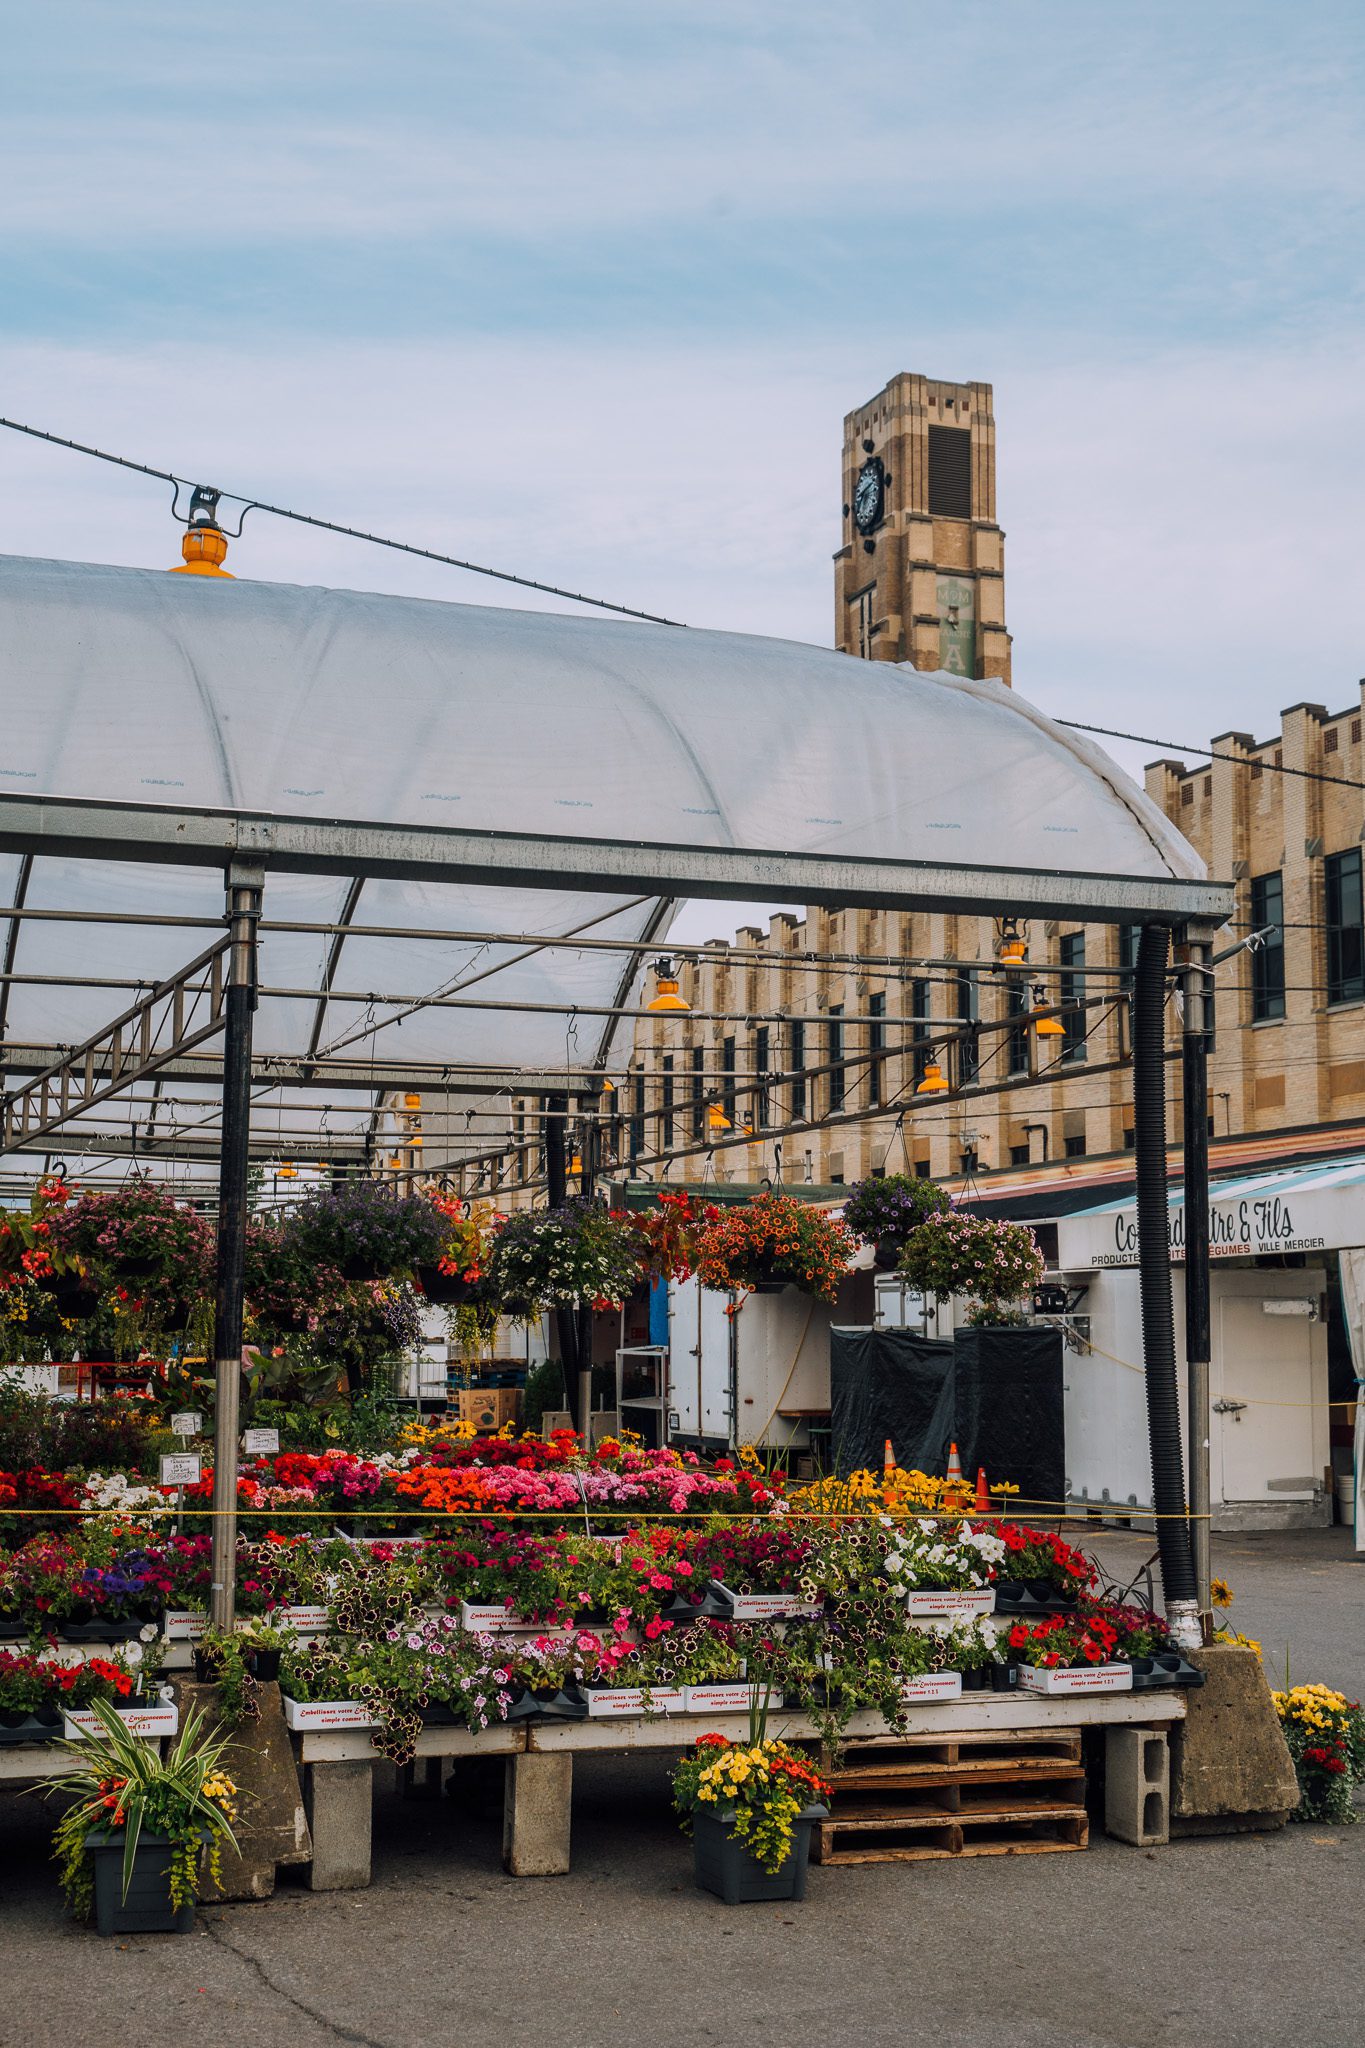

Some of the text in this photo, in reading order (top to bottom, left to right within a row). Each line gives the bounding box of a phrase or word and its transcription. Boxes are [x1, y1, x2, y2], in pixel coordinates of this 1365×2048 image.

[1239, 1200, 1251, 1243] &
[1254, 1197, 1294, 1240] Fils
[1208, 1243, 1251, 1256] ÉGUMES
[1258, 1241, 1280, 1252] VILLE
[1284, 1237, 1325, 1251] MERCIER
[592, 1695, 627, 1703] Embellissez
[691, 1692, 724, 1700] Embellissez
[300, 1709, 336, 1717] Embellissez
